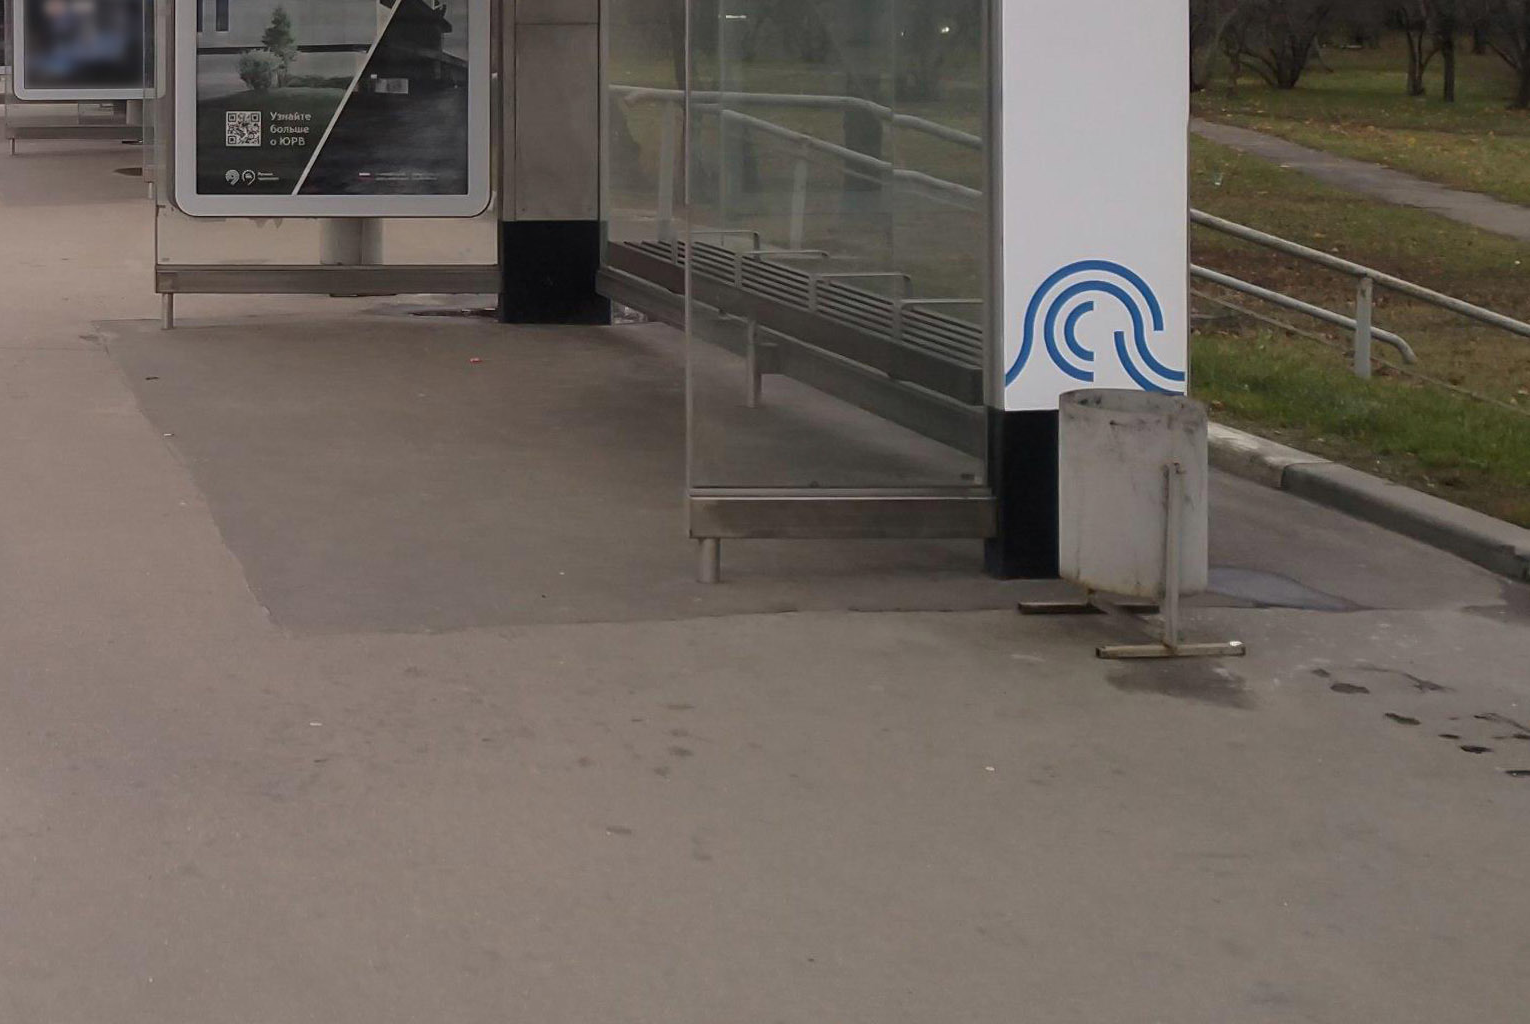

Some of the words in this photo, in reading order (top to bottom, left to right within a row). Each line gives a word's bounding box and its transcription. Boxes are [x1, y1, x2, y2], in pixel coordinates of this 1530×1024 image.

[269, 111, 312, 121] Узнайте
[269, 123, 310, 134] больше
[279, 136, 306, 146] ЮРВ
